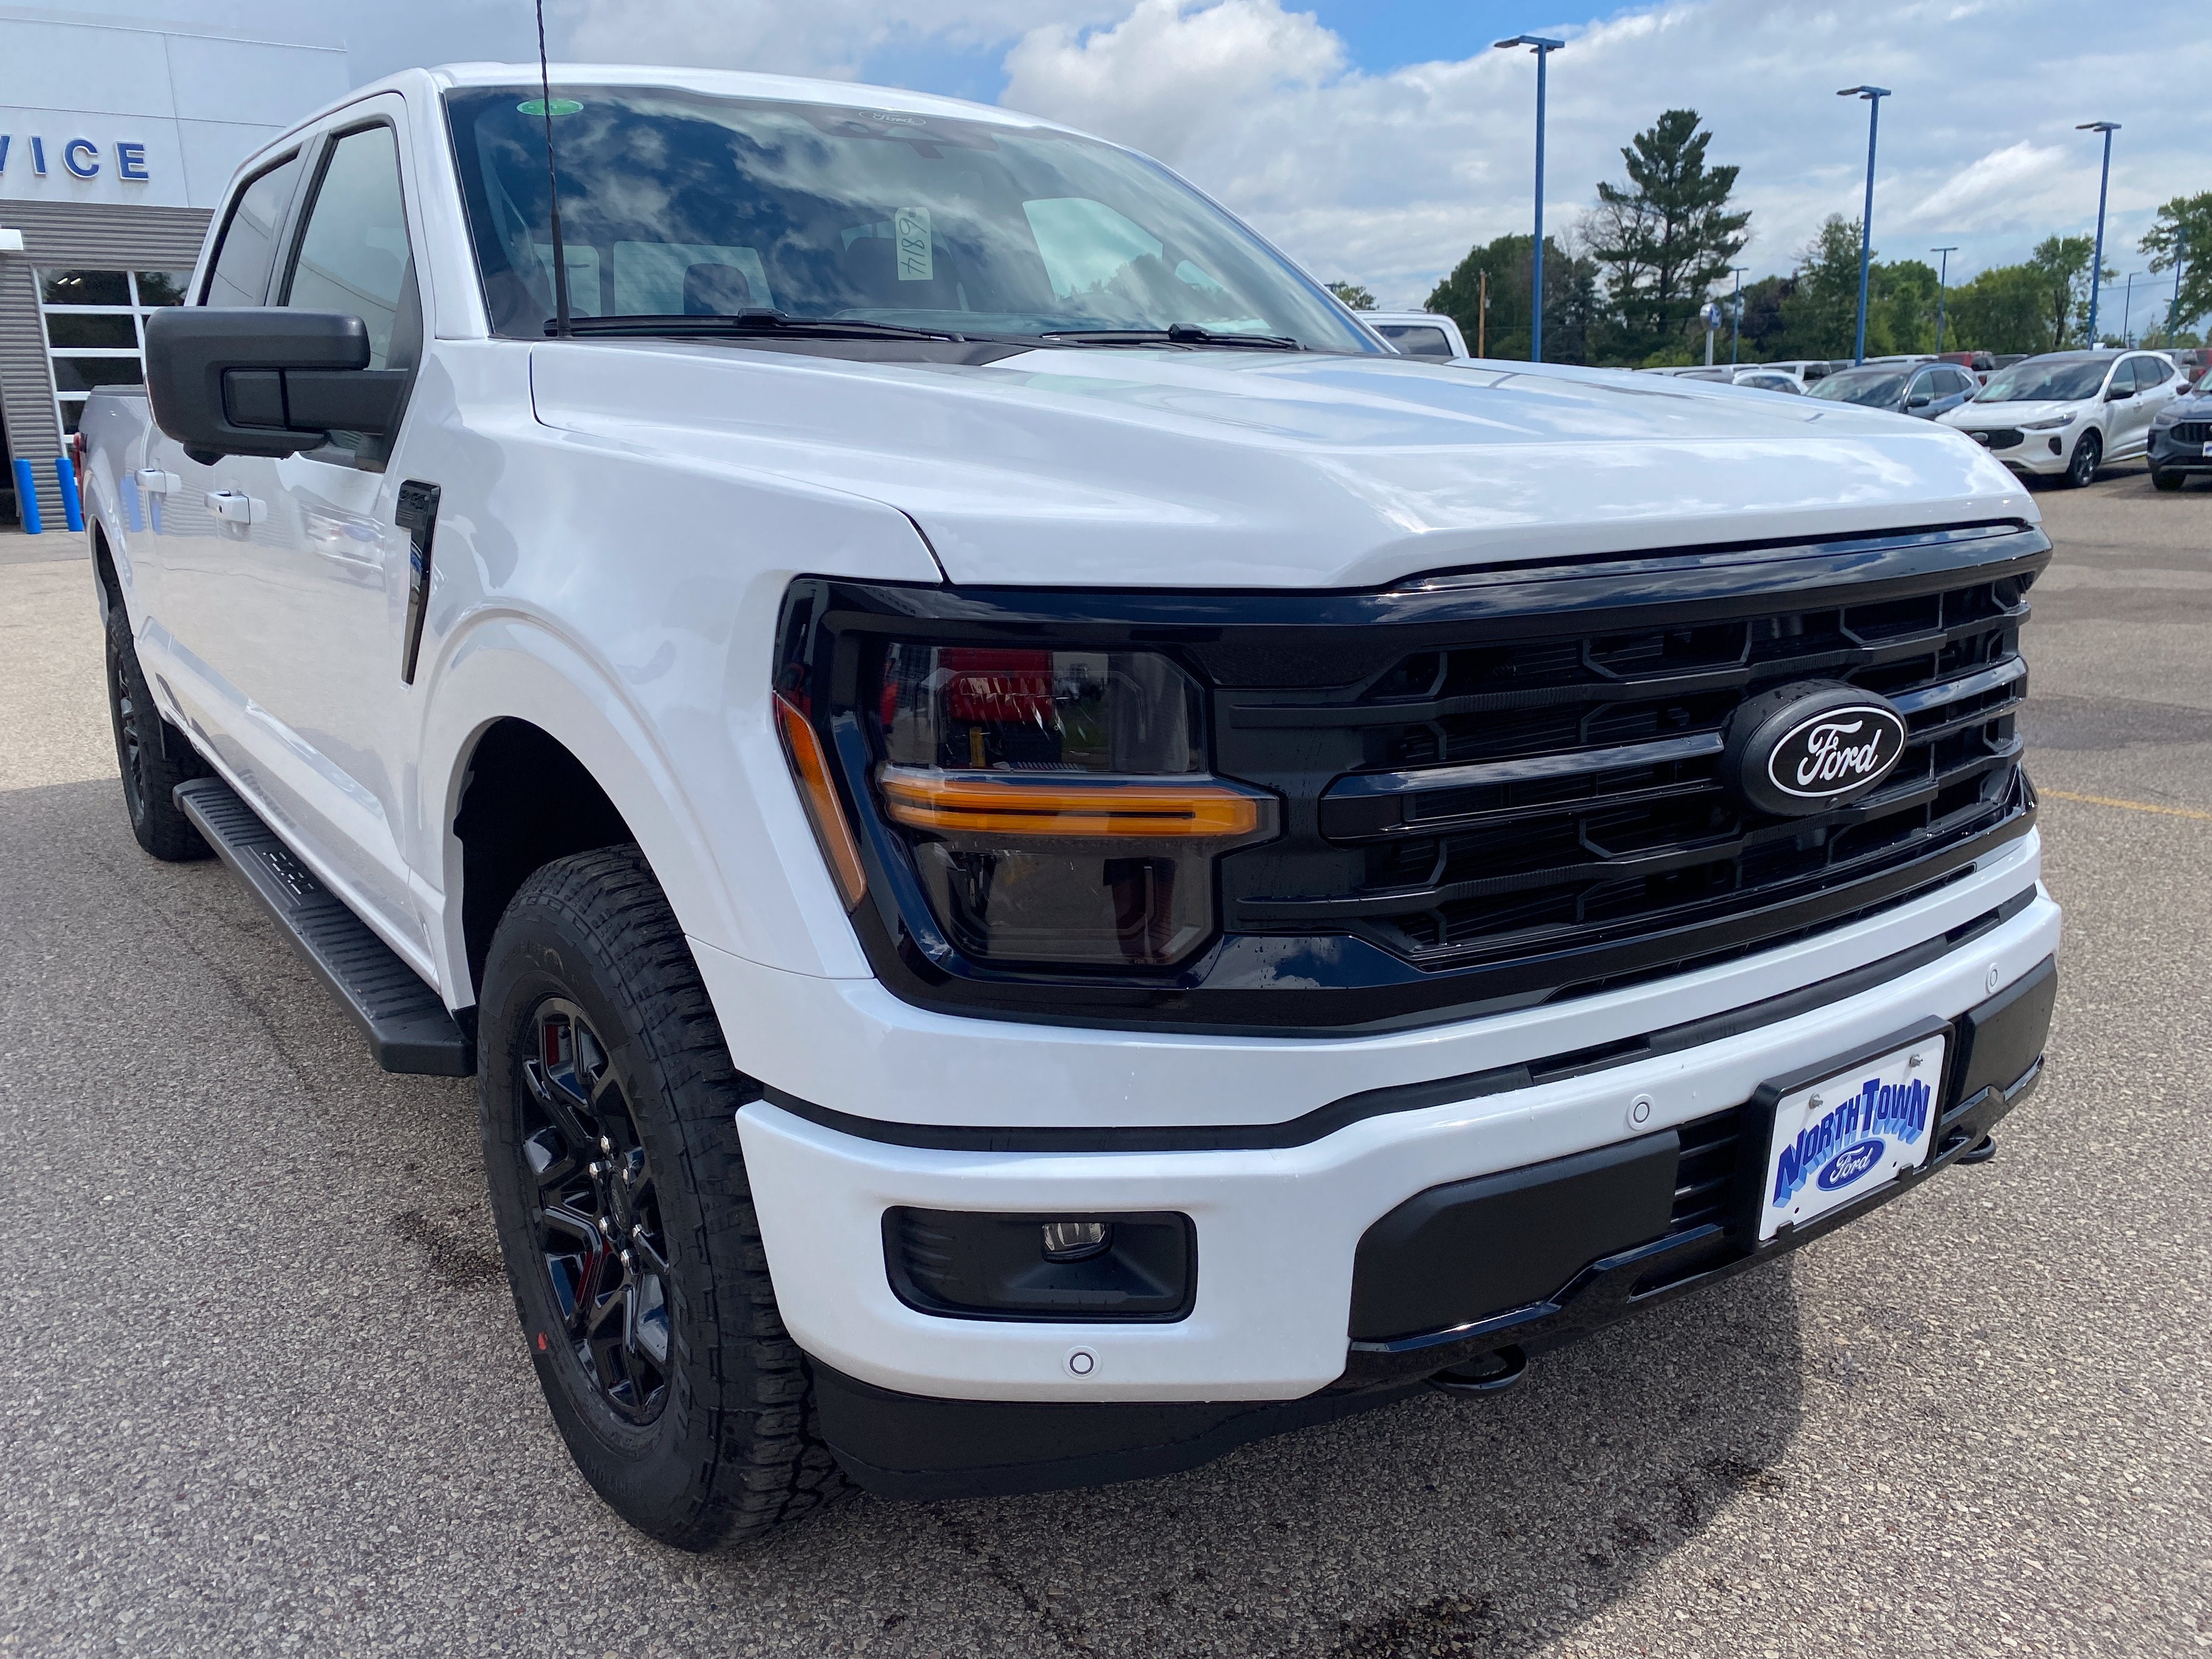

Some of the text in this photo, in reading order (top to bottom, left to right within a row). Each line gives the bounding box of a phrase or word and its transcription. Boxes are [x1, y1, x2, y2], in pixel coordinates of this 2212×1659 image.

[872, 112, 915, 124] Ford
[899, 217, 927, 274] 6814
[1797, 720, 1882, 786] Ford
[1829, 1146, 1874, 1184] Ford
